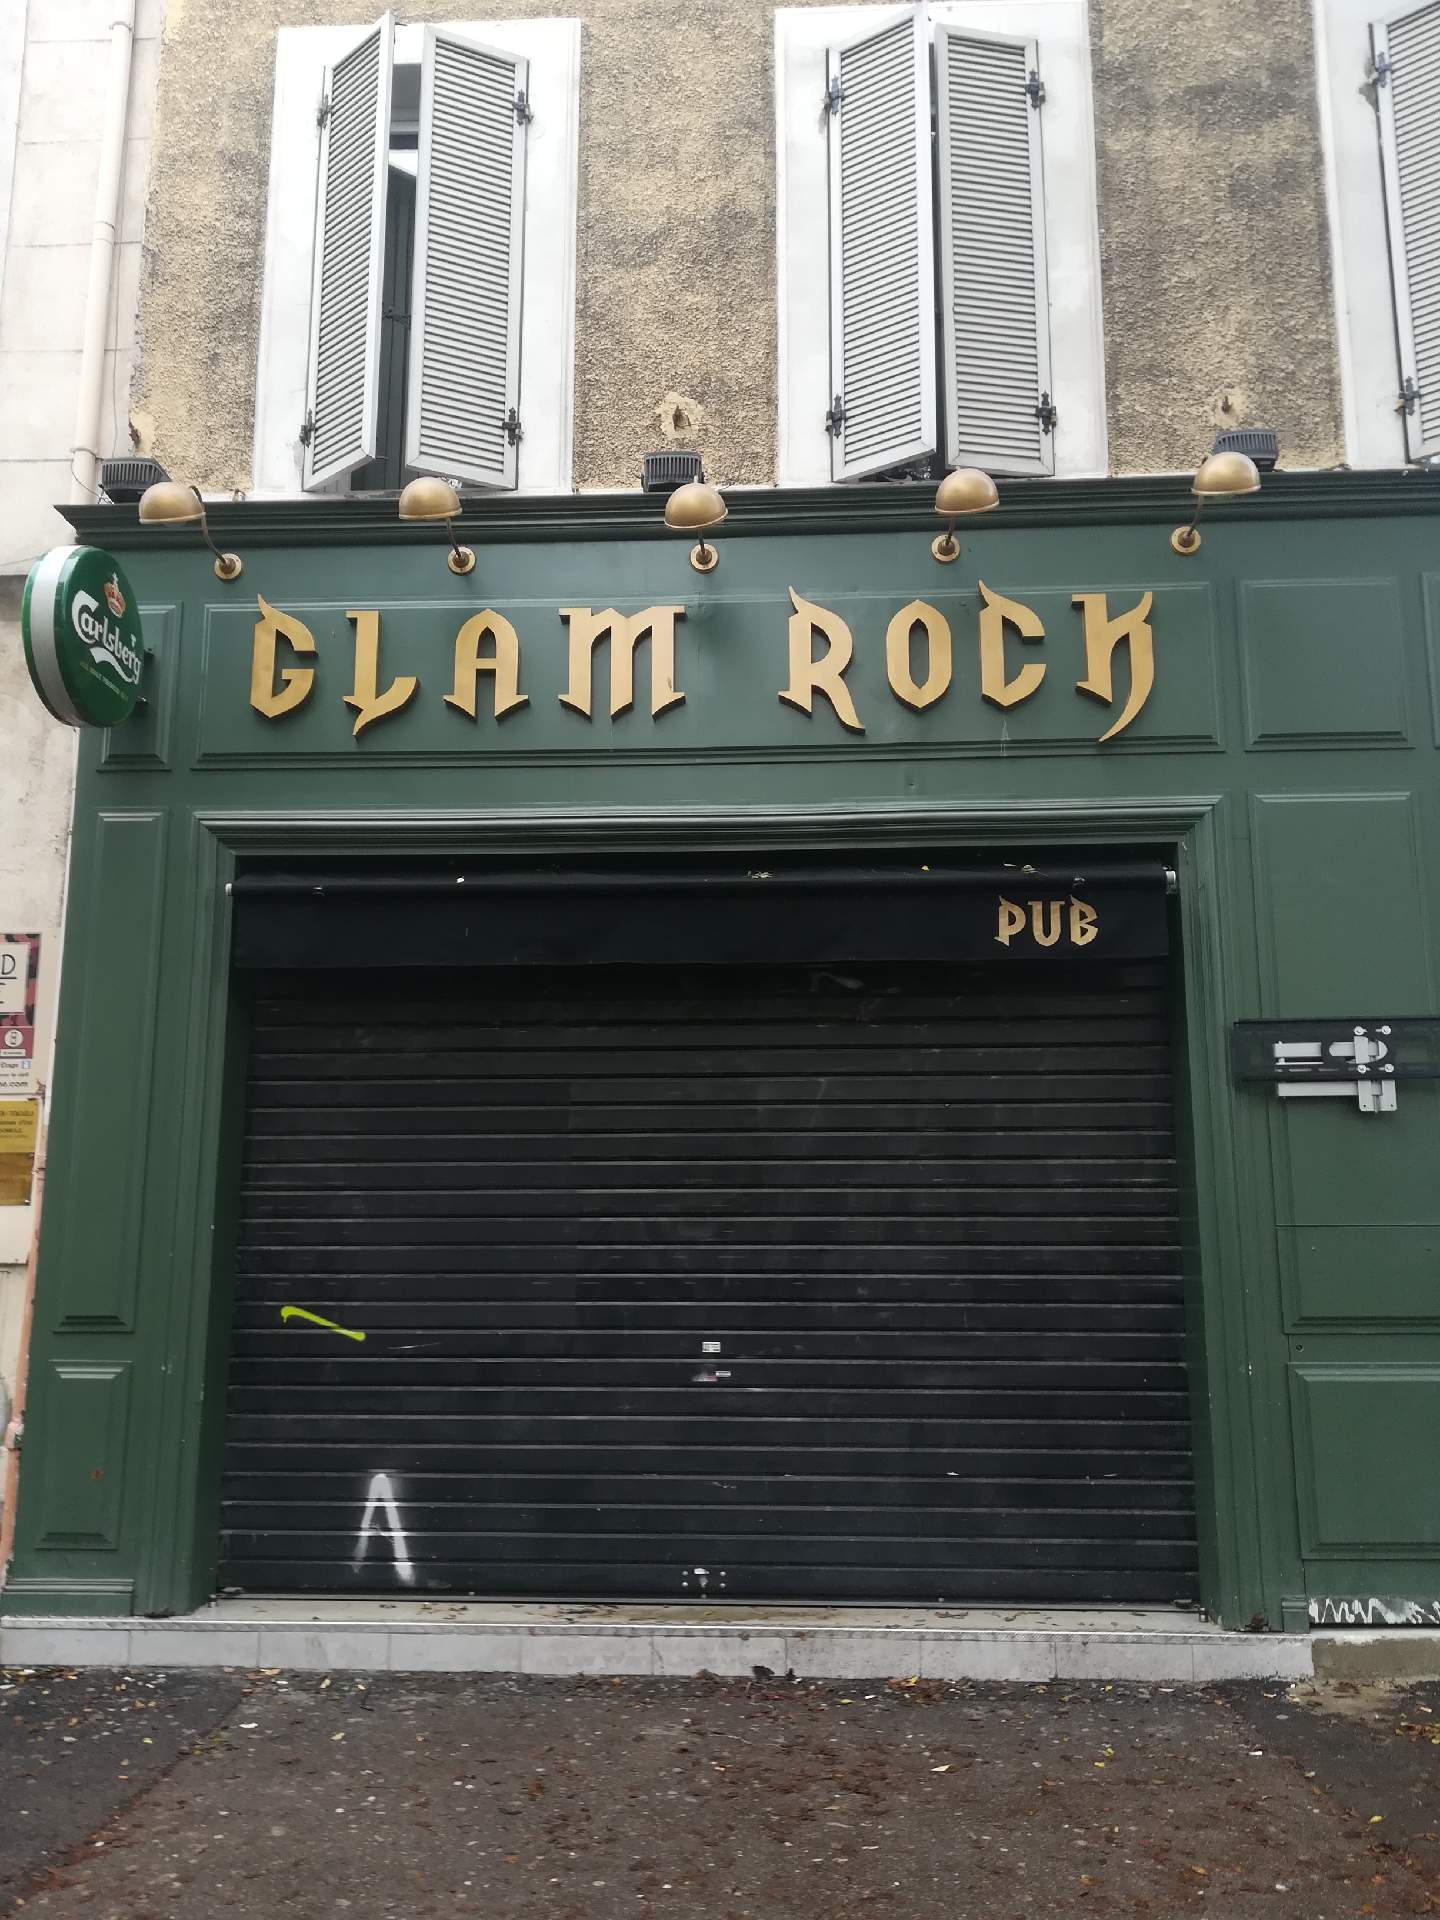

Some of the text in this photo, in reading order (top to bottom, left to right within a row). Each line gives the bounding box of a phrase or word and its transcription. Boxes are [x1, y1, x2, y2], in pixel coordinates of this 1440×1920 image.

[72, 590, 141, 684] Carlsberg
[248, 580, 1156, 742] GLAM ROCK
[994, 894, 1099, 946] PUB
